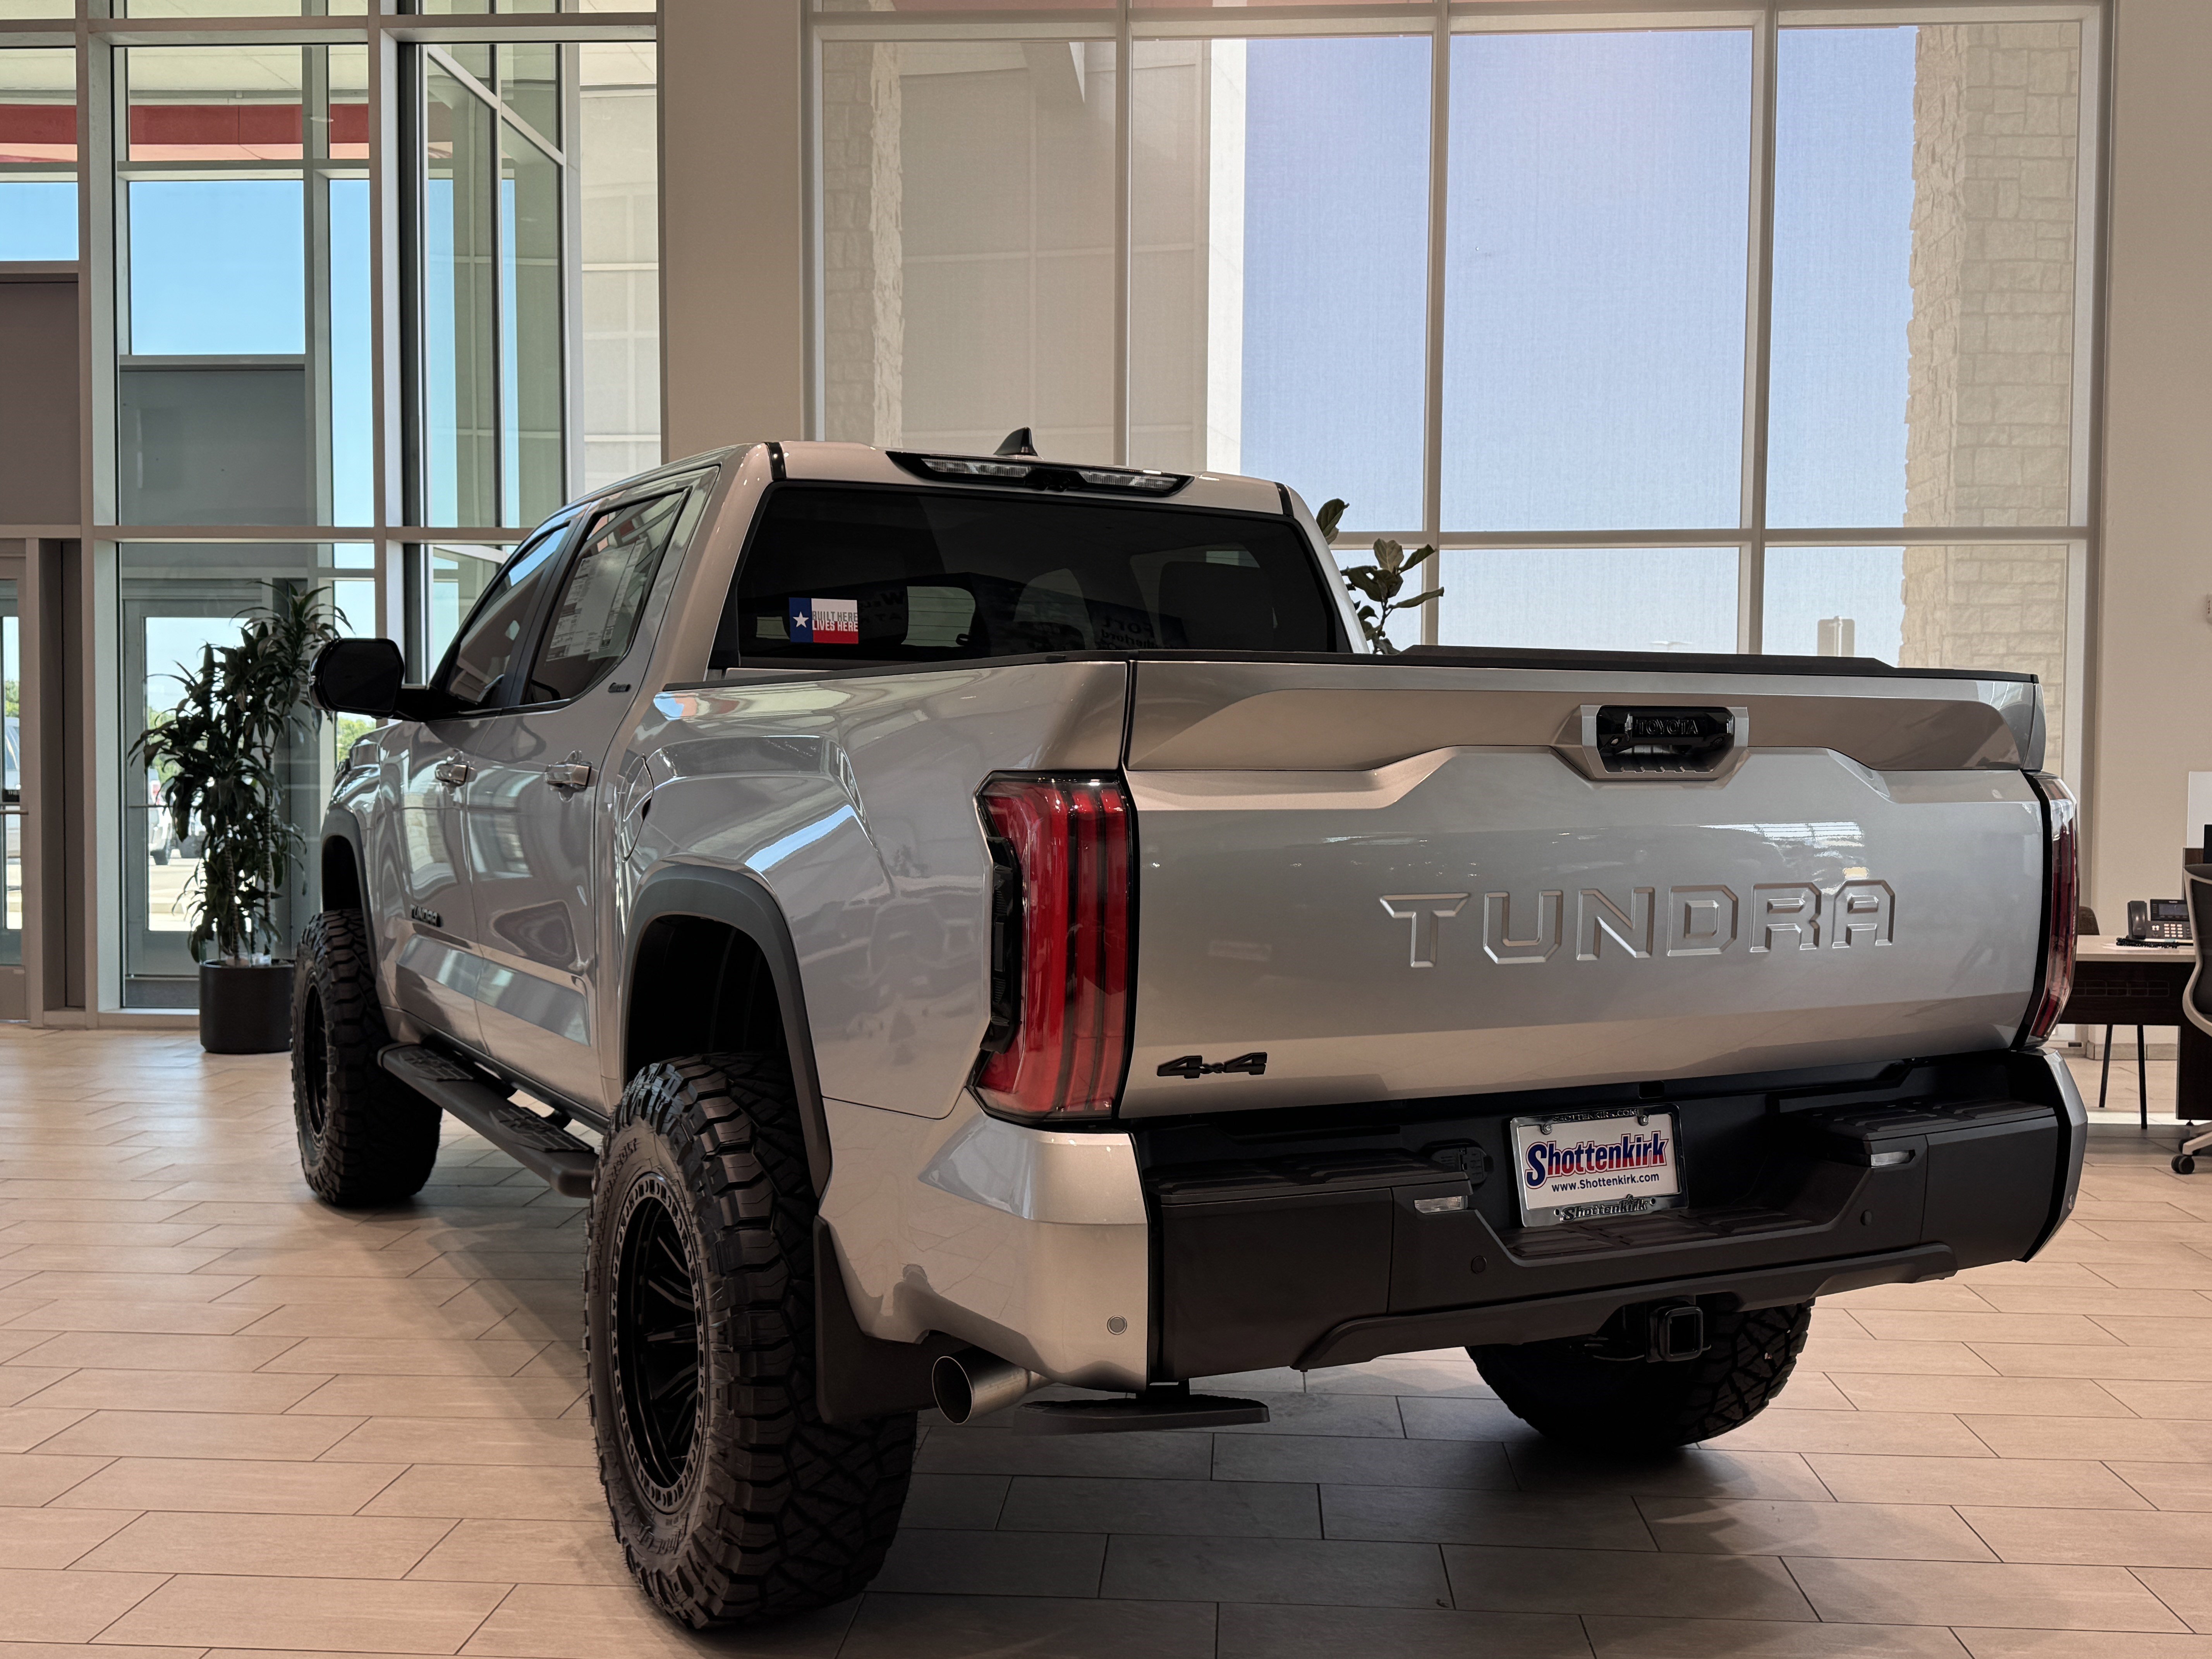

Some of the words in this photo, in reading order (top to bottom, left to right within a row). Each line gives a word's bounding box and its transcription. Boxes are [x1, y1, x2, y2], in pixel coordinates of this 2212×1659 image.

[812, 611, 835, 621] BUILT
[837, 611, 858, 622] HERE
[812, 620, 835, 631] LIVES
[837, 621, 859, 632] HERE
[1636, 719, 1699, 735] TOYOTA
[1379, 879, 1896, 968] TUNDRA
[1525, 1130, 1669, 1189] Shottenkirk
[1551, 1172, 1660, 1192] www.Shottenkirk.com
[1559, 1194, 1649, 1222] Shottenkirk
